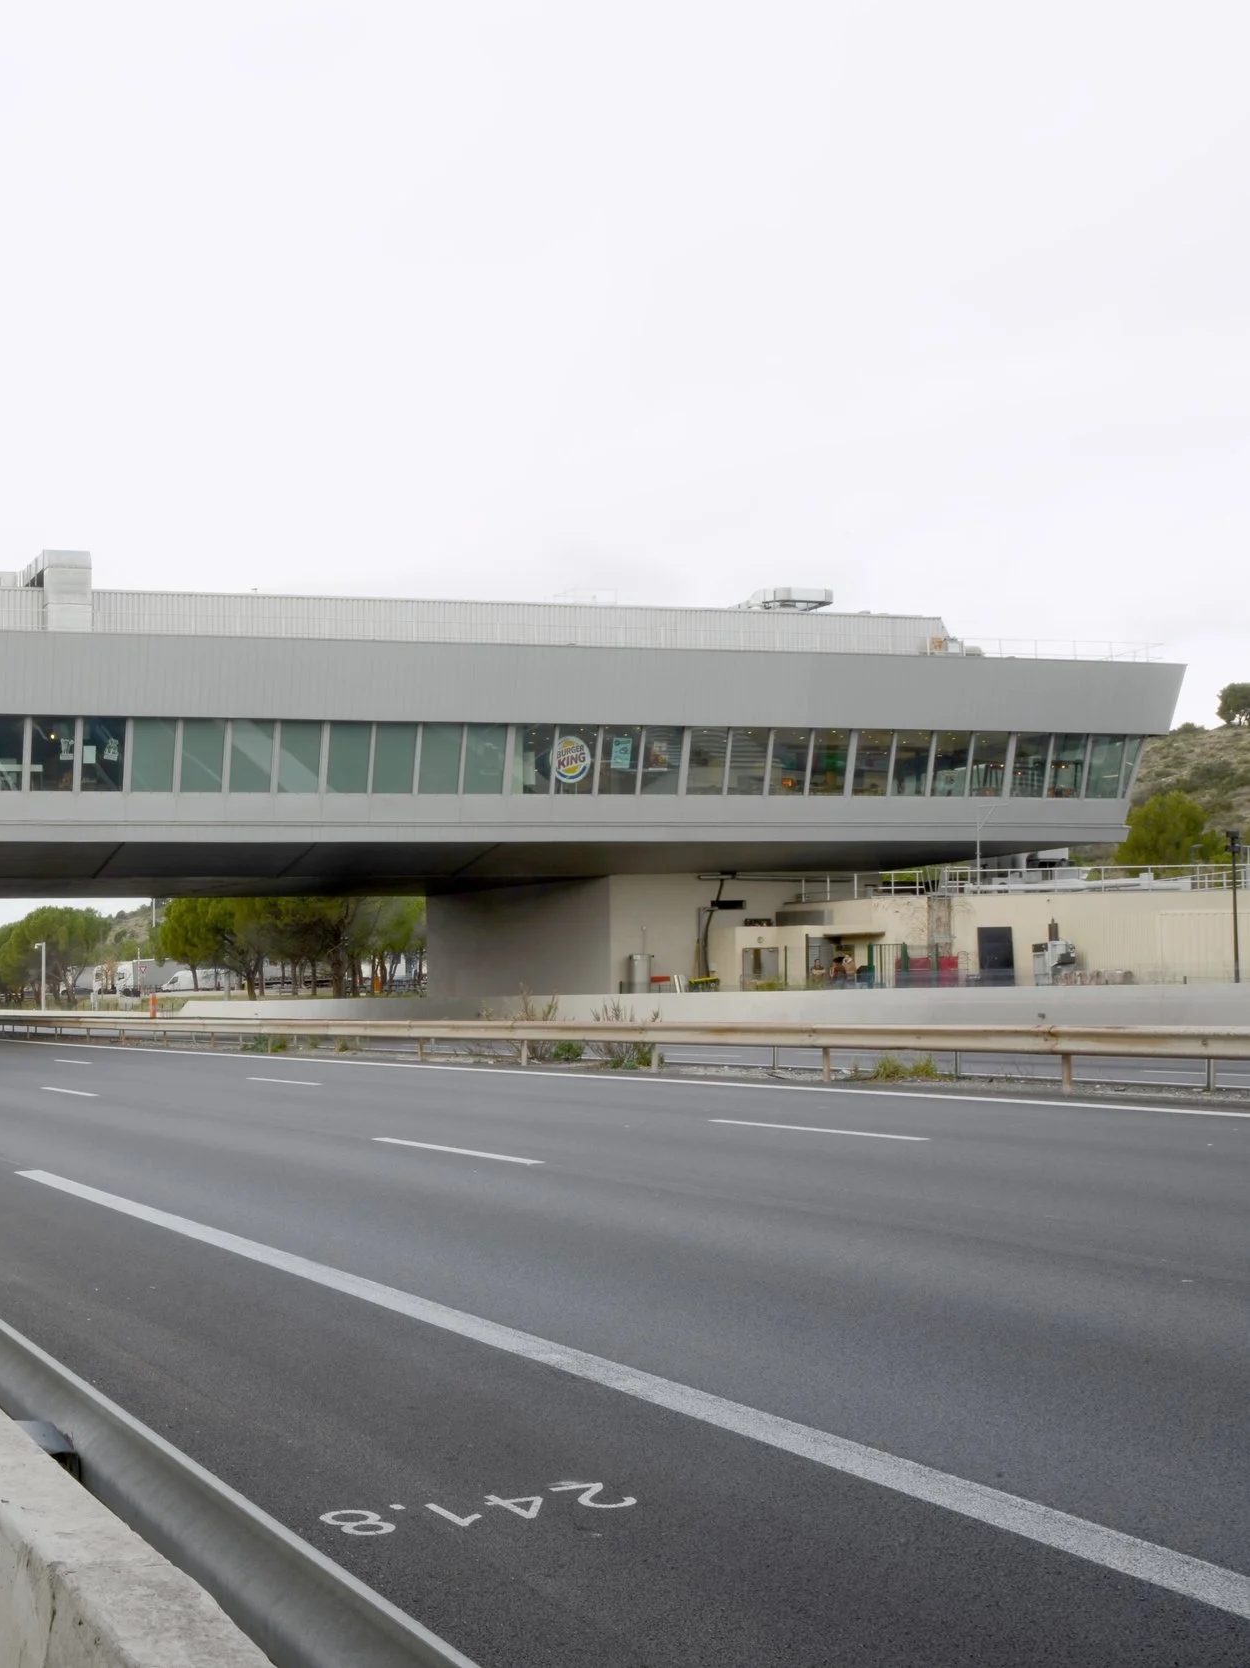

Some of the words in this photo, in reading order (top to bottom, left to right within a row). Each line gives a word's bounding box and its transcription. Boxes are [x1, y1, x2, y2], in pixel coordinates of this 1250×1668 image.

[556, 744, 585, 759] BURGER
[557, 752, 586, 770] KING
[318, 1481, 637, 1536] 241.8
